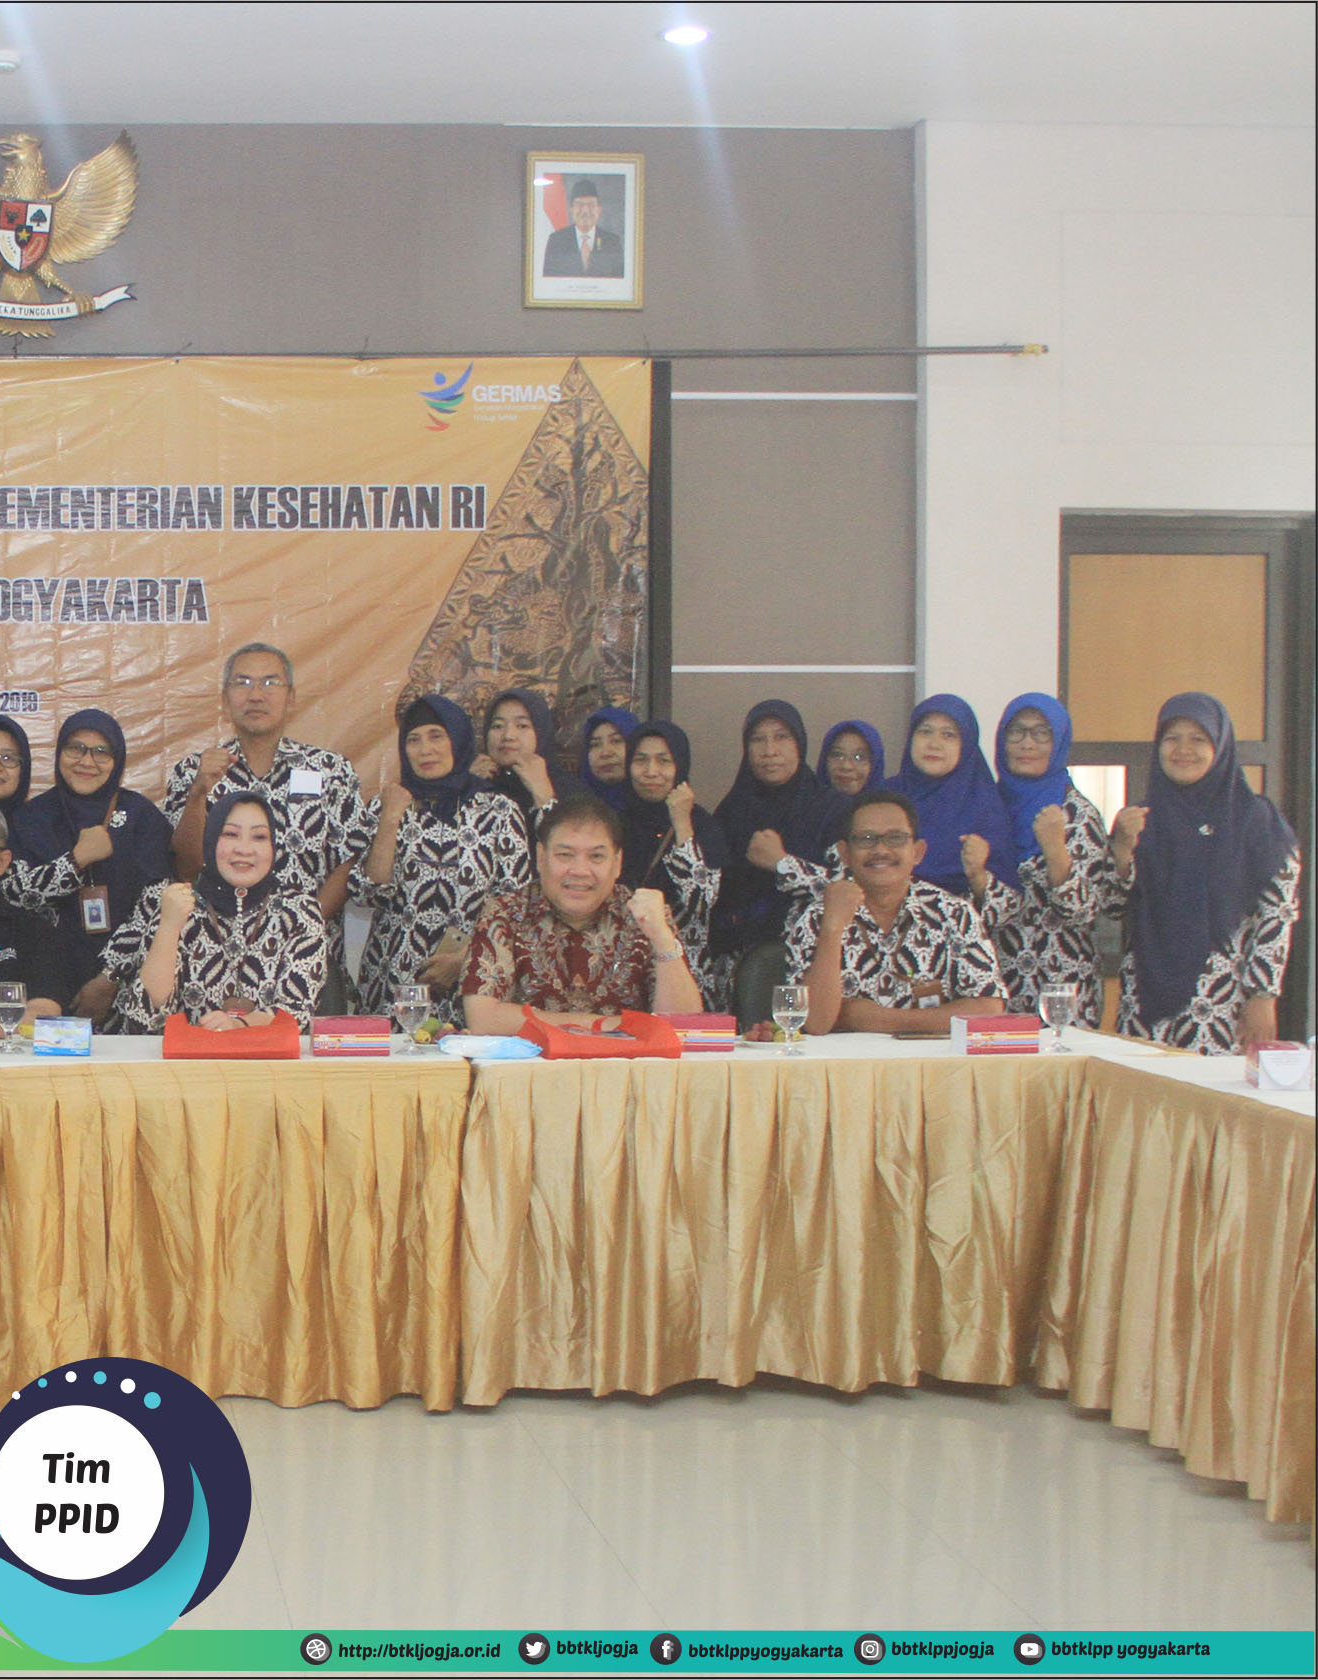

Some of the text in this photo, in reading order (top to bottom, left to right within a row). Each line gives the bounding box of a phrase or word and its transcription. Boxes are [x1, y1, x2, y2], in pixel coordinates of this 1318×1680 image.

[471, 383, 561, 404] GERMAS
[232, 485, 442, 531] KESEHATAN
[450, 485, 487, 531] RI
